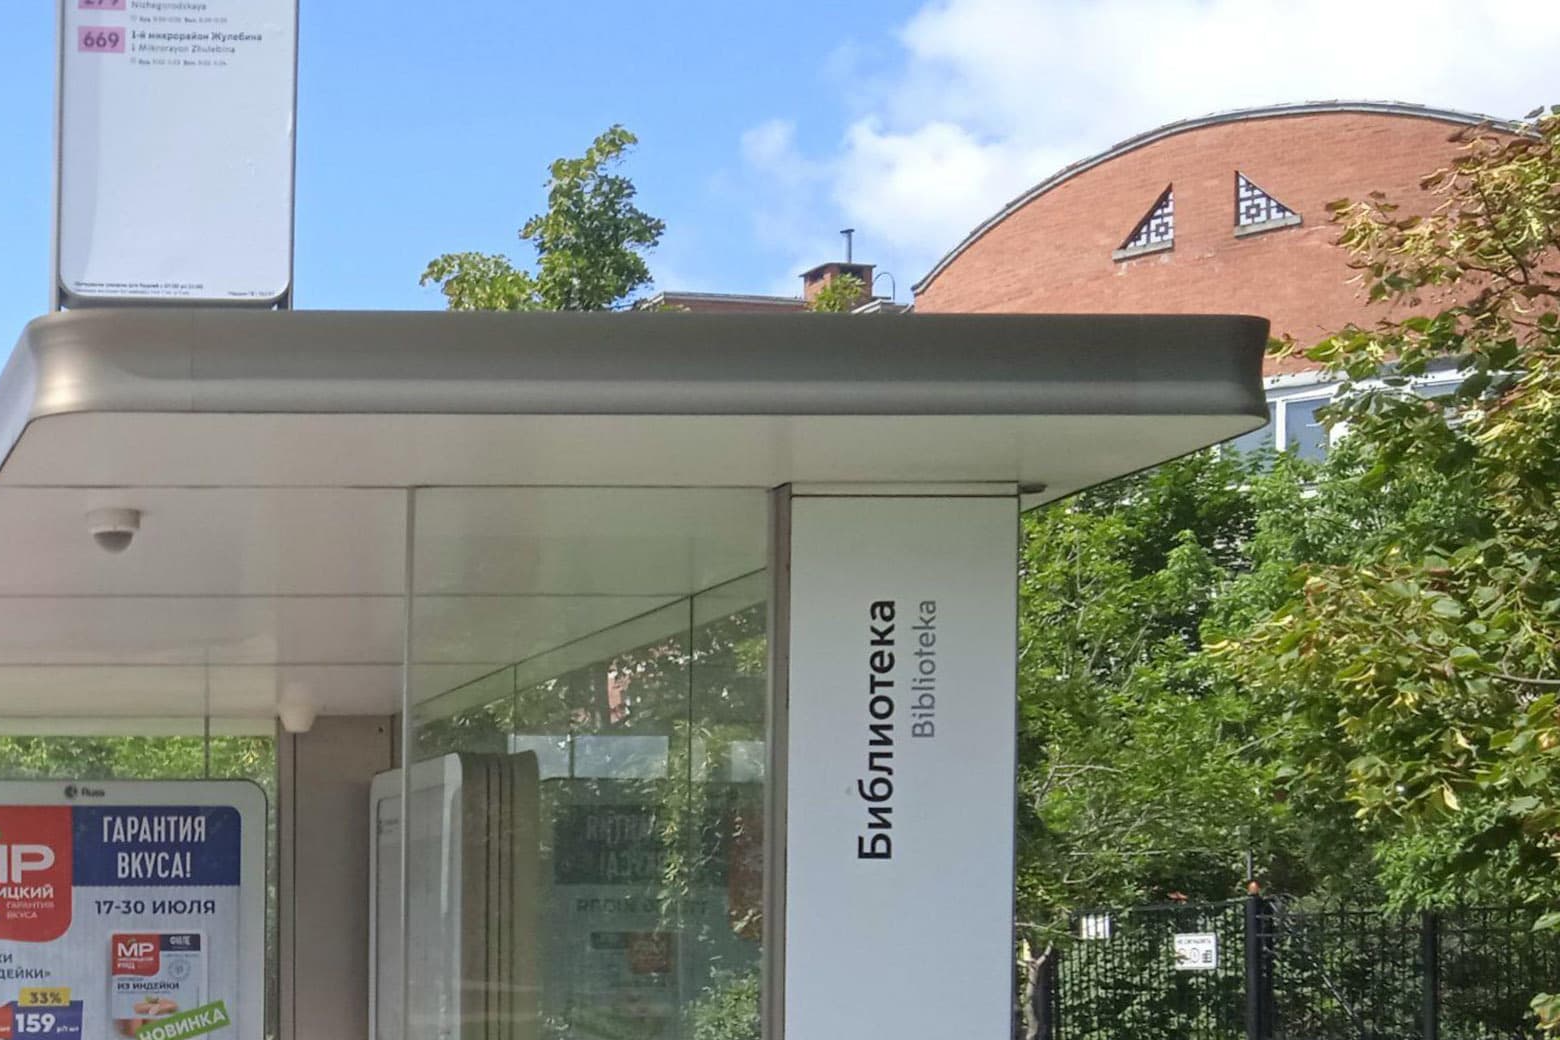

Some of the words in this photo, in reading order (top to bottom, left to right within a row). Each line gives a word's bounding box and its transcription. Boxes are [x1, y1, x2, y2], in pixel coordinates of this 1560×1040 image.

[83, 32, 120, 49] 669
[211, 32, 263, 42] Жулебина
[911, 600, 937, 738] Biblioteka
[857, 600, 896, 860] Библиотека
[103, 815, 206, 843] ГАРАНТИЯ
[116, 851, 192, 879] ВКУСА!
[95, 900, 145, 916] 17-30
[152, 900, 216, 915] ИЮЛЯ
[29, 992, 62, 1004] 33%
[15, 1013, 56, 1033] 159
